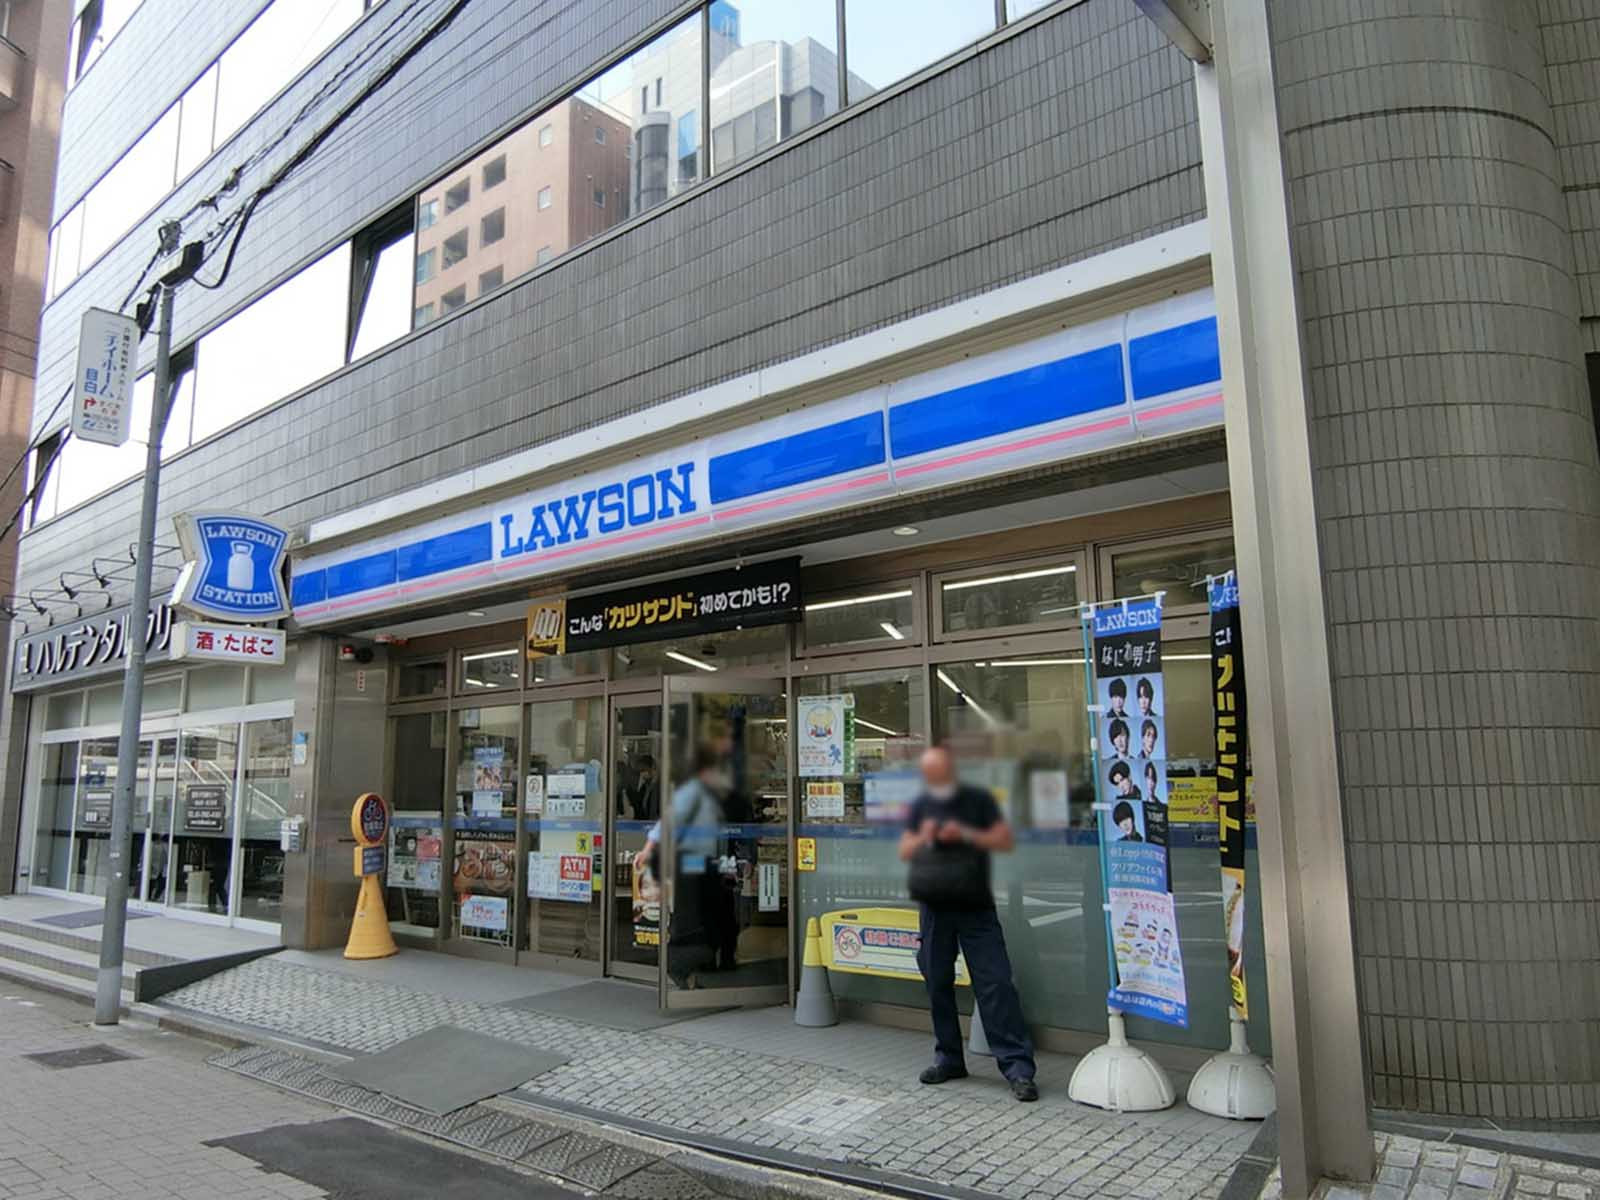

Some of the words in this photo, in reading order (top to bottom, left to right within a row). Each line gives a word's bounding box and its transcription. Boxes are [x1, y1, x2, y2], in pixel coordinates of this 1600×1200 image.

[84, 367, 98, 394] 目白
[500, 461, 697, 558] LAWSON
[205, 525, 279, 548] LAWSON
[202, 584, 275, 605] STATION
[1095, 607, 1158, 632] LAWSON
[196, 631, 274, 656] 酒・たばこ
[1102, 641, 1156, 668] なにわ男子
[563, 857, 588, 872] ATM
[718, 855, 737, 873] 24
